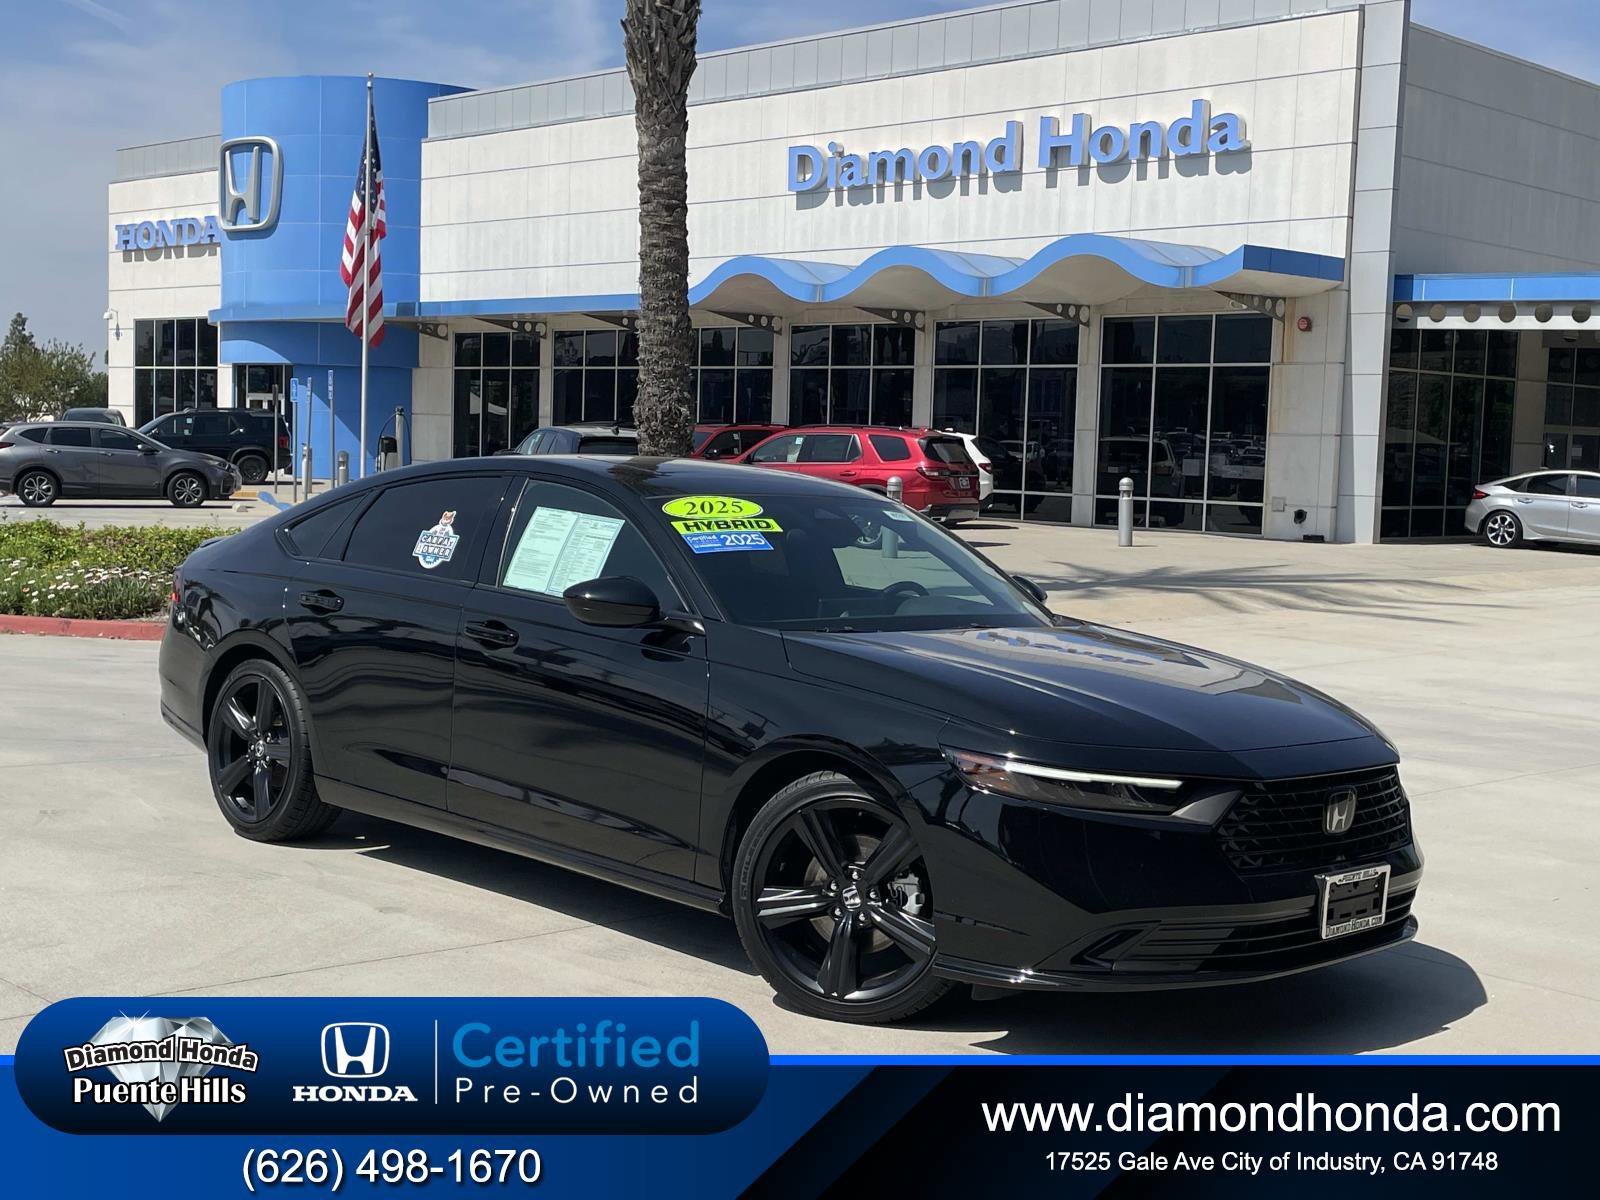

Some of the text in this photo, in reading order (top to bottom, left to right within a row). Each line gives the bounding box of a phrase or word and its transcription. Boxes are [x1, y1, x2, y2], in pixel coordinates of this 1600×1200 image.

[787, 98, 1251, 193] Diamond Honda
[115, 216, 220, 251] HONDA
[684, 500, 744, 515] 2025
[683, 519, 772, 532] HYBRID
[720, 533, 766, 546] 2025
